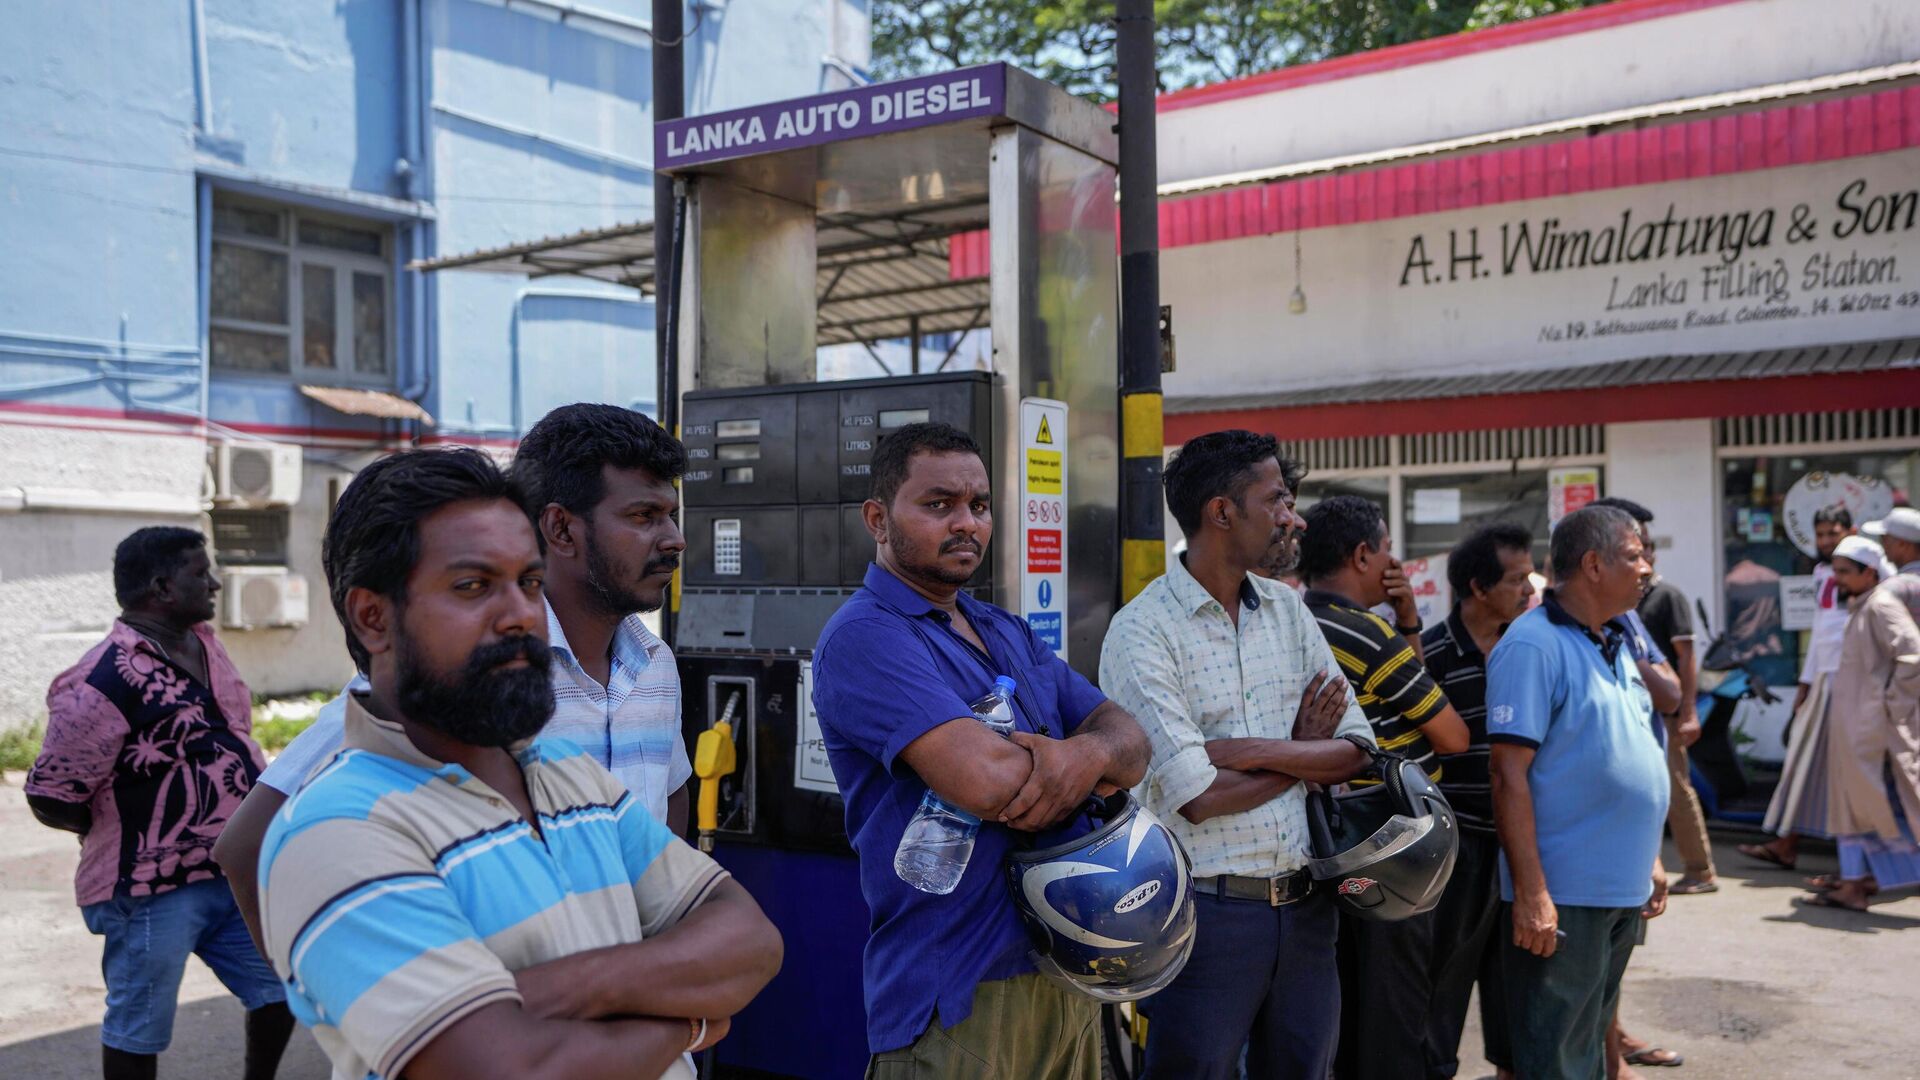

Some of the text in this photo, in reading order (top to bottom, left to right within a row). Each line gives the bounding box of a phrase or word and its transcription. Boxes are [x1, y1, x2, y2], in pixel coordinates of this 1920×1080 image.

[666, 78, 991, 157] LANKA AUTO DIESEL
[1500, 202, 1777, 277] Wimalatunga
[1786, 203, 1818, 245] &
[1605, 250, 1901, 312] Lanka Filling Station.
